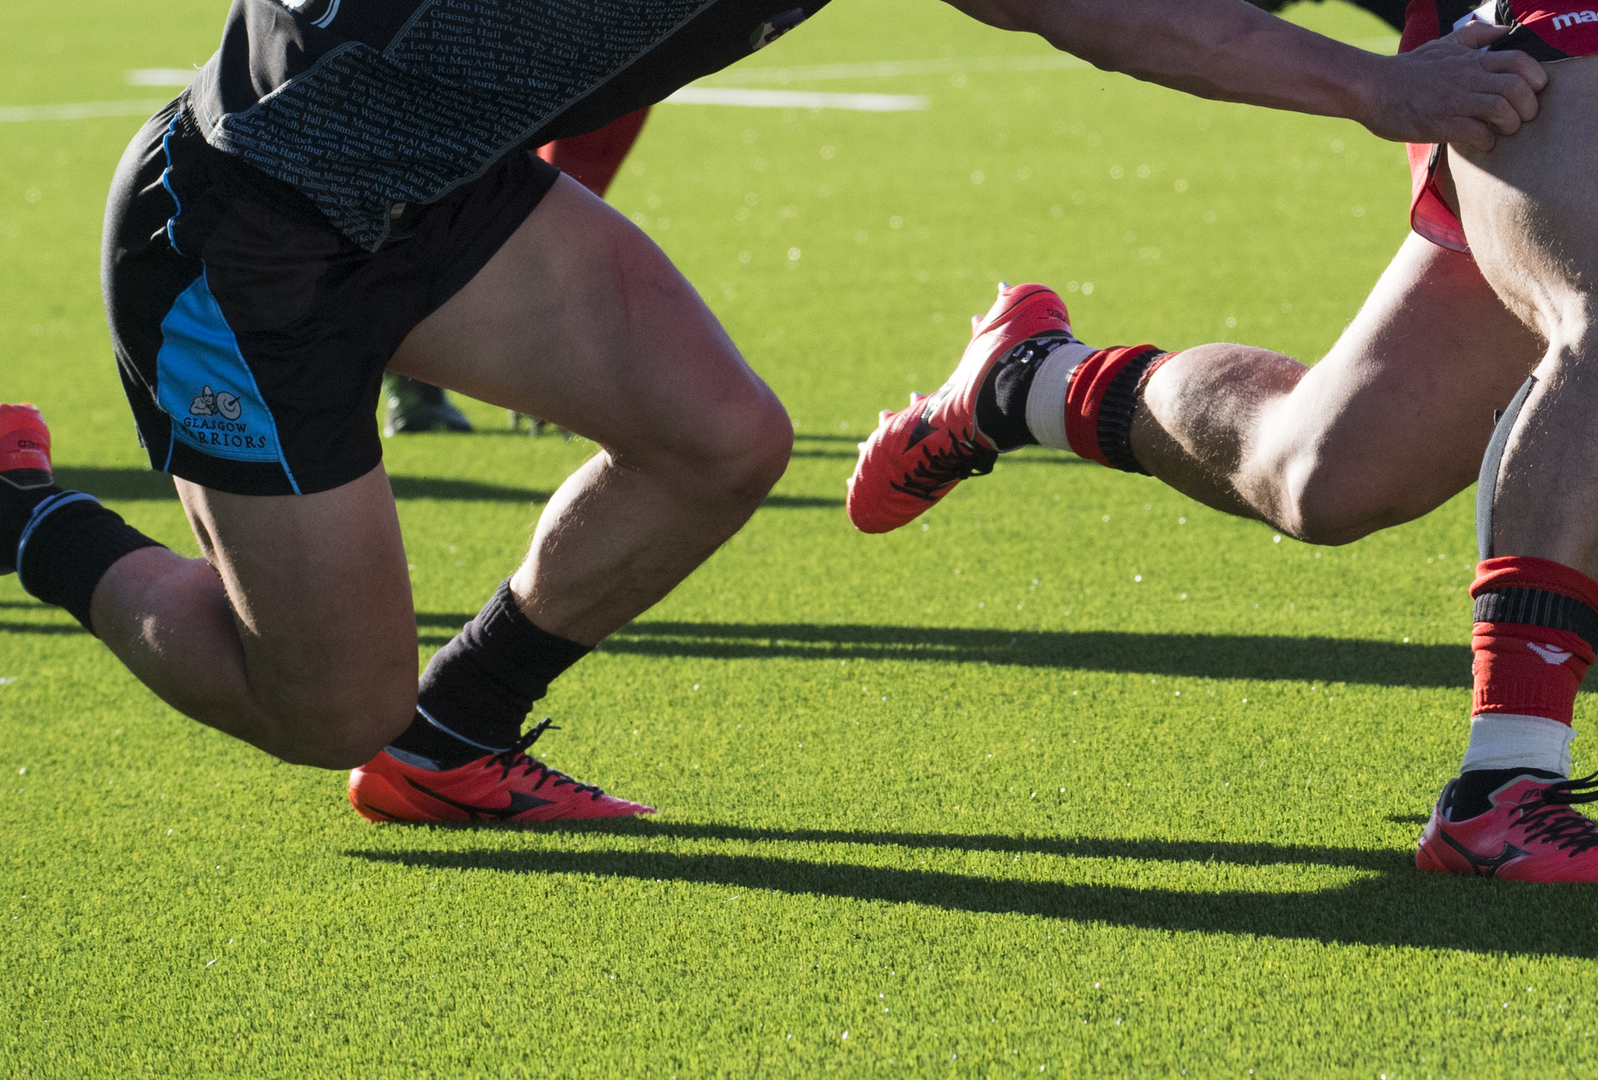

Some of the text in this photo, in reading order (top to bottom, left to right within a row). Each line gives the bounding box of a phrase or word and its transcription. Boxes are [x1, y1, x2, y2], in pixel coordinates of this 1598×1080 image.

[430, 10, 475, 24] Graeme
[479, 15, 534, 38] Morrison
[446, 0, 470, 11] Rob
[474, 5, 514, 22] Harley
[520, 17, 567, 39] Duncan
[432, 21, 579, 60] Dougie Hall Andy Hall
[432, 31, 476, 45] Ruaridh
[479, 39, 525, 54] Jackson
[449, 56, 510, 72] MacArthur
[514, 65, 529, 75] Ed
[453, 45, 495, 59] Kellock
[500, 53, 526, 65] John
[437, 65, 459, 75] Rob
[462, 68, 499, 80] Harley
[528, 78, 558, 91] Welsh
[323, 120, 359, 137] Johnnie
[183, 416, 247, 434] GLASGOW
